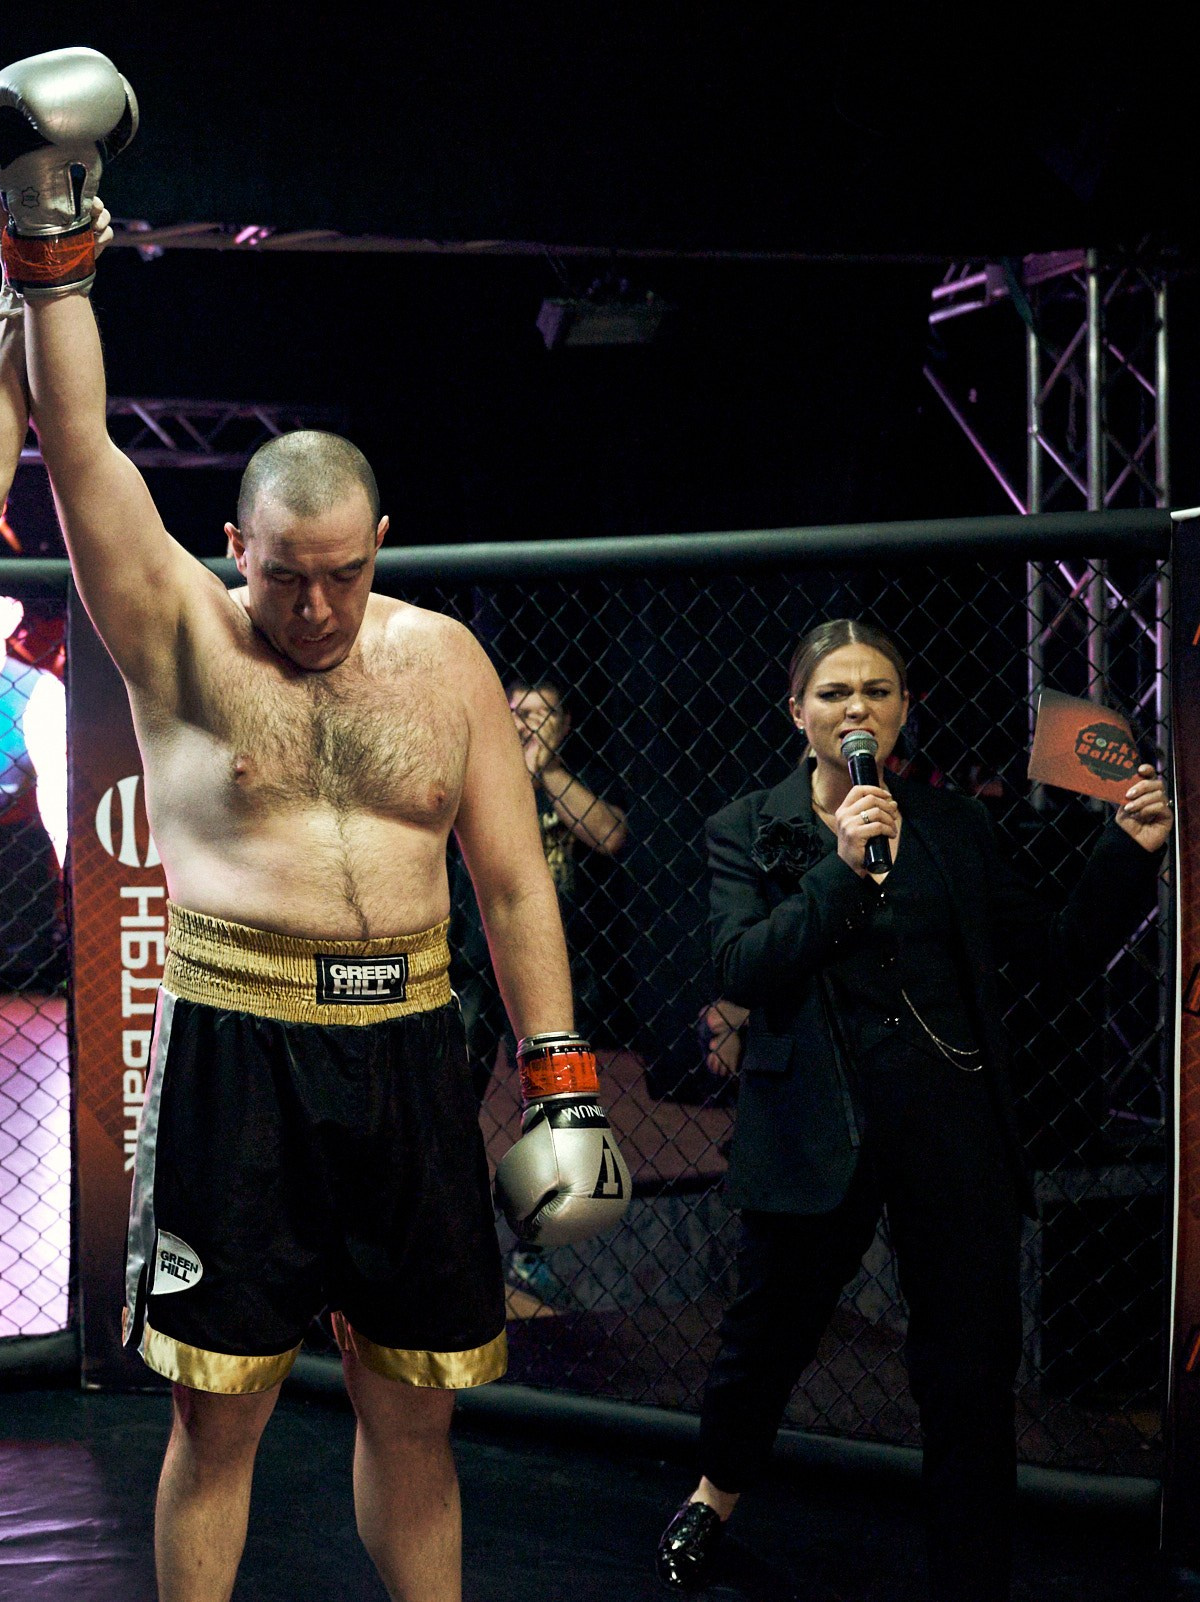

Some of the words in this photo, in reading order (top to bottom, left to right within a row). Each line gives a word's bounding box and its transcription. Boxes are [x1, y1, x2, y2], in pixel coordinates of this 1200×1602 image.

[330, 964, 400, 980] GREEN
[333, 979, 390, 995] HILL
[561, 1105, 605, 1122] TINUM
[160, 1250, 198, 1274] GREEN
[161, 1261, 190, 1283] HILL
